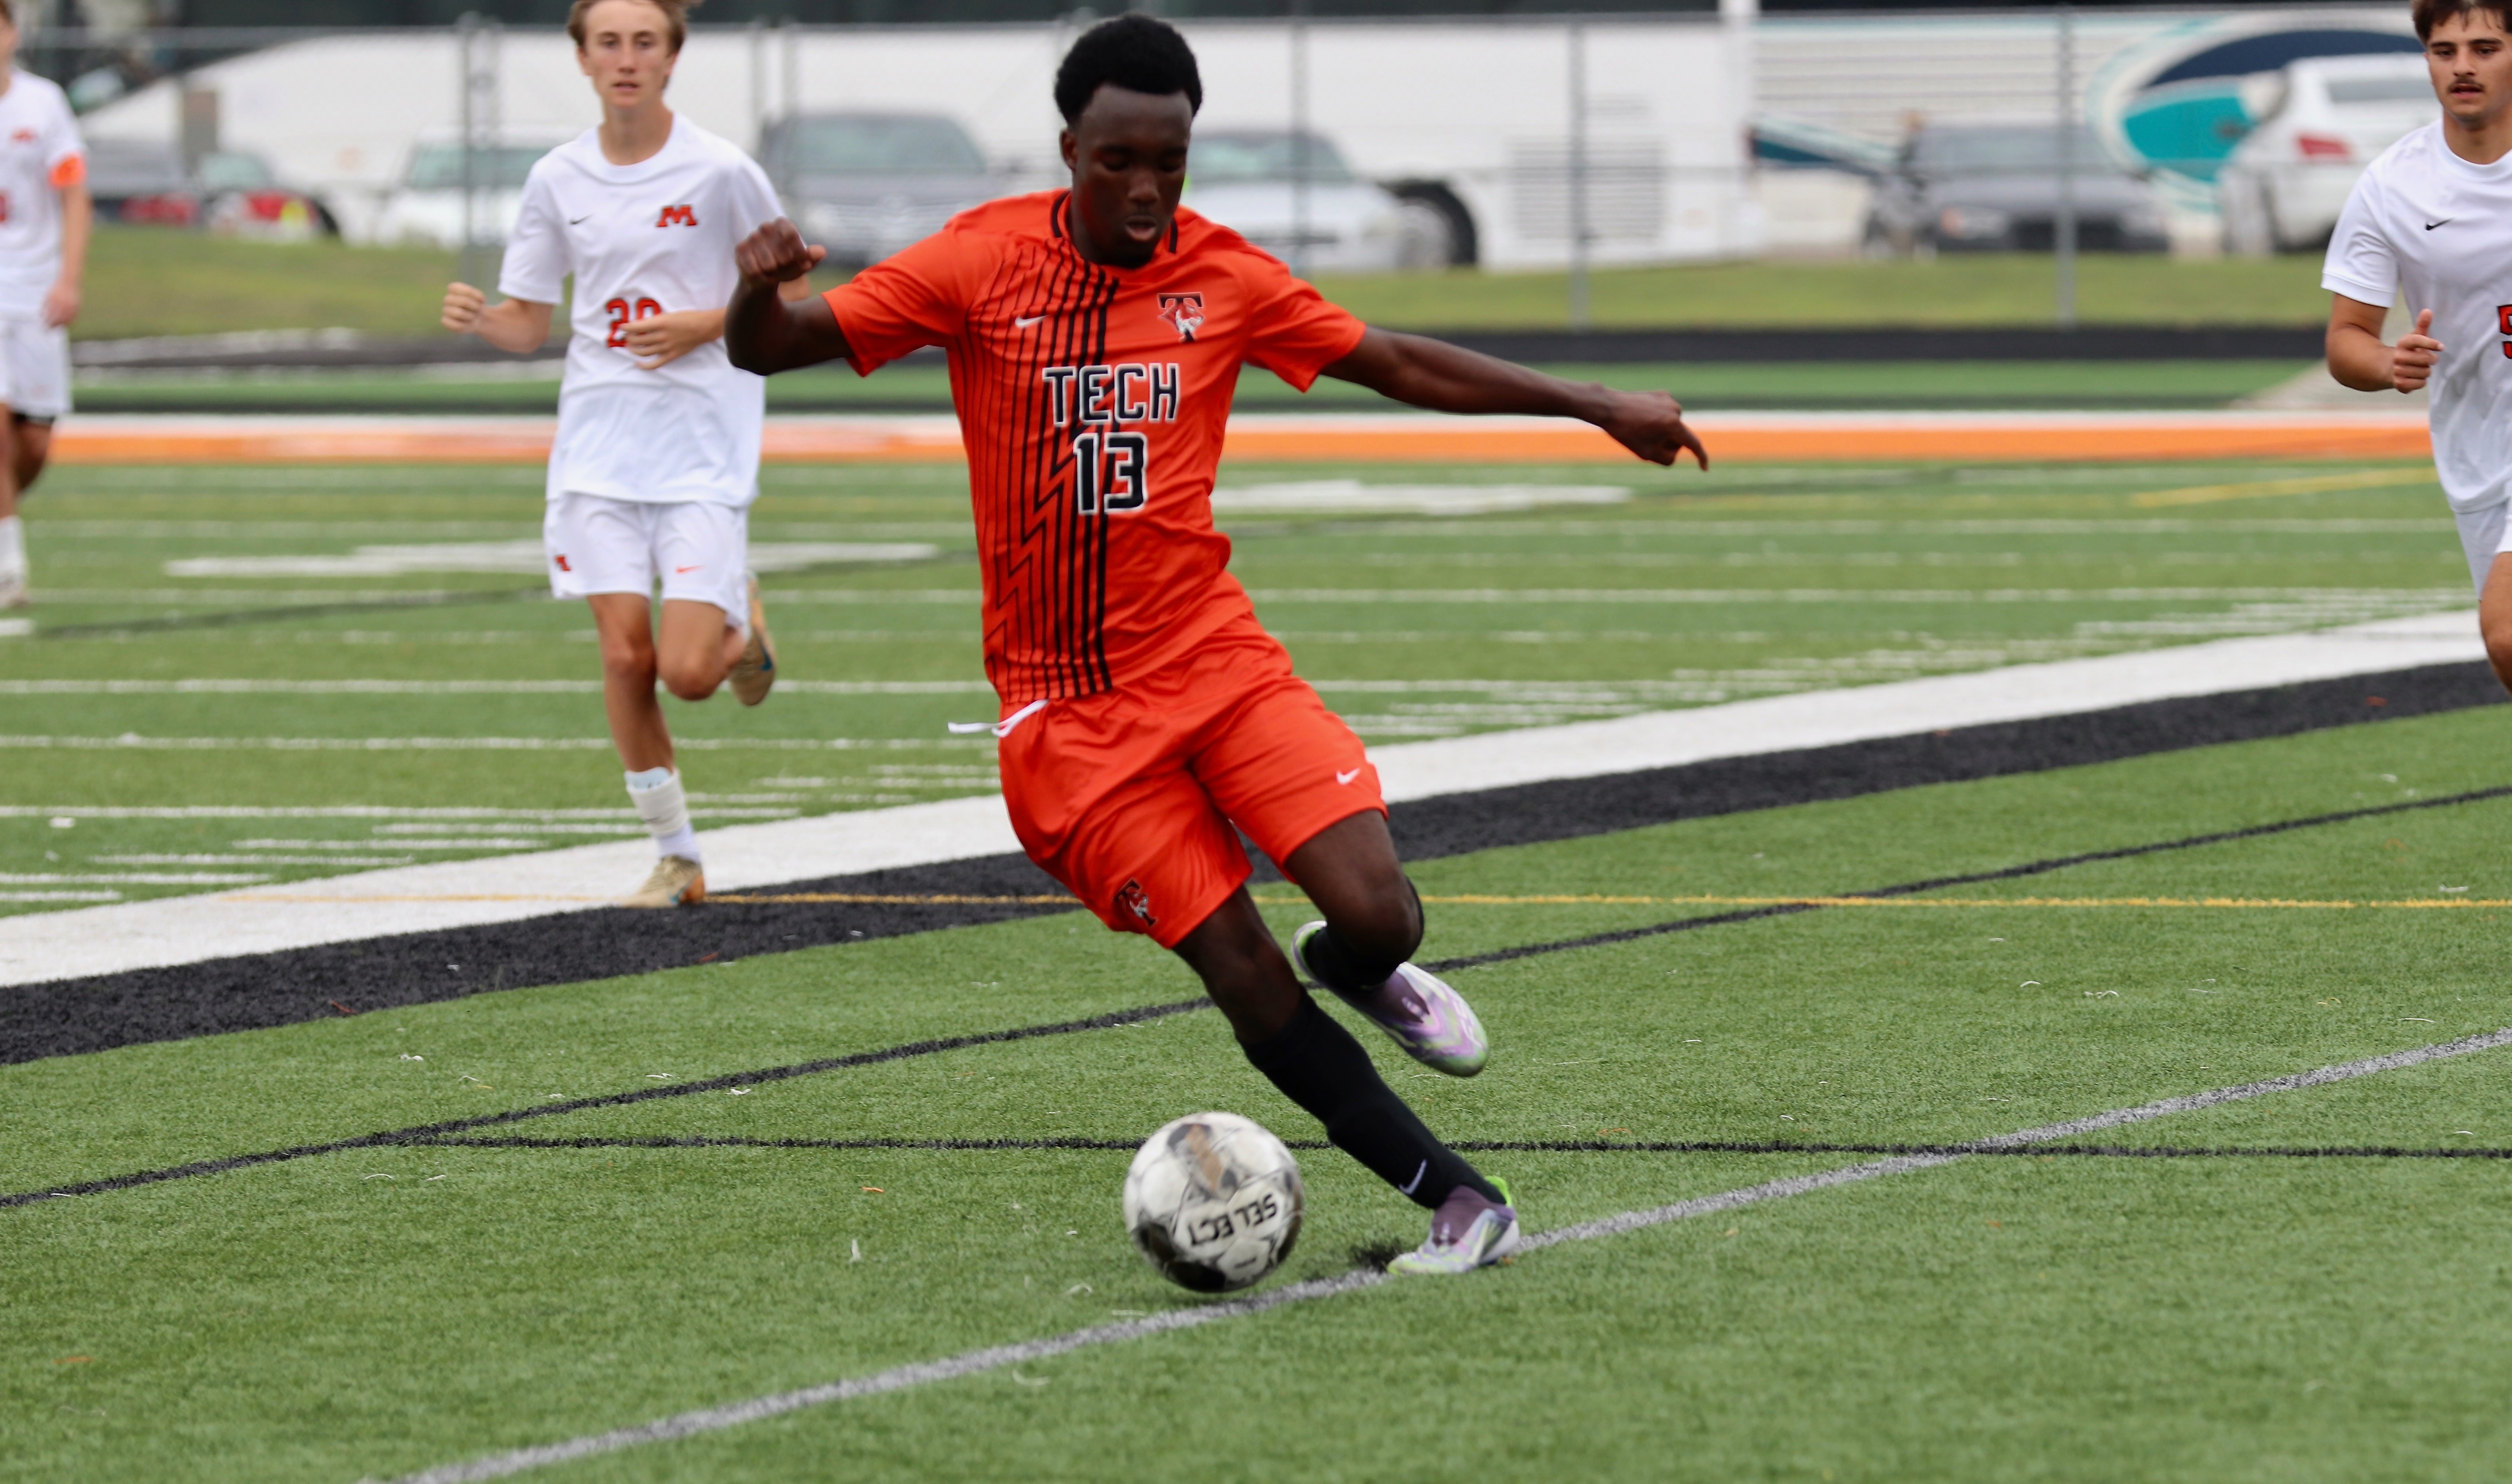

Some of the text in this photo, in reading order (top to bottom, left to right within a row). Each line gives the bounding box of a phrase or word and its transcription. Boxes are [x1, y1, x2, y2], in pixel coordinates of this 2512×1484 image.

[655, 205, 698, 228] M
[1042, 363, 1179, 427] TECH
[1073, 432, 1148, 515] 13
[1187, 1193, 1278, 1247] SELECT
